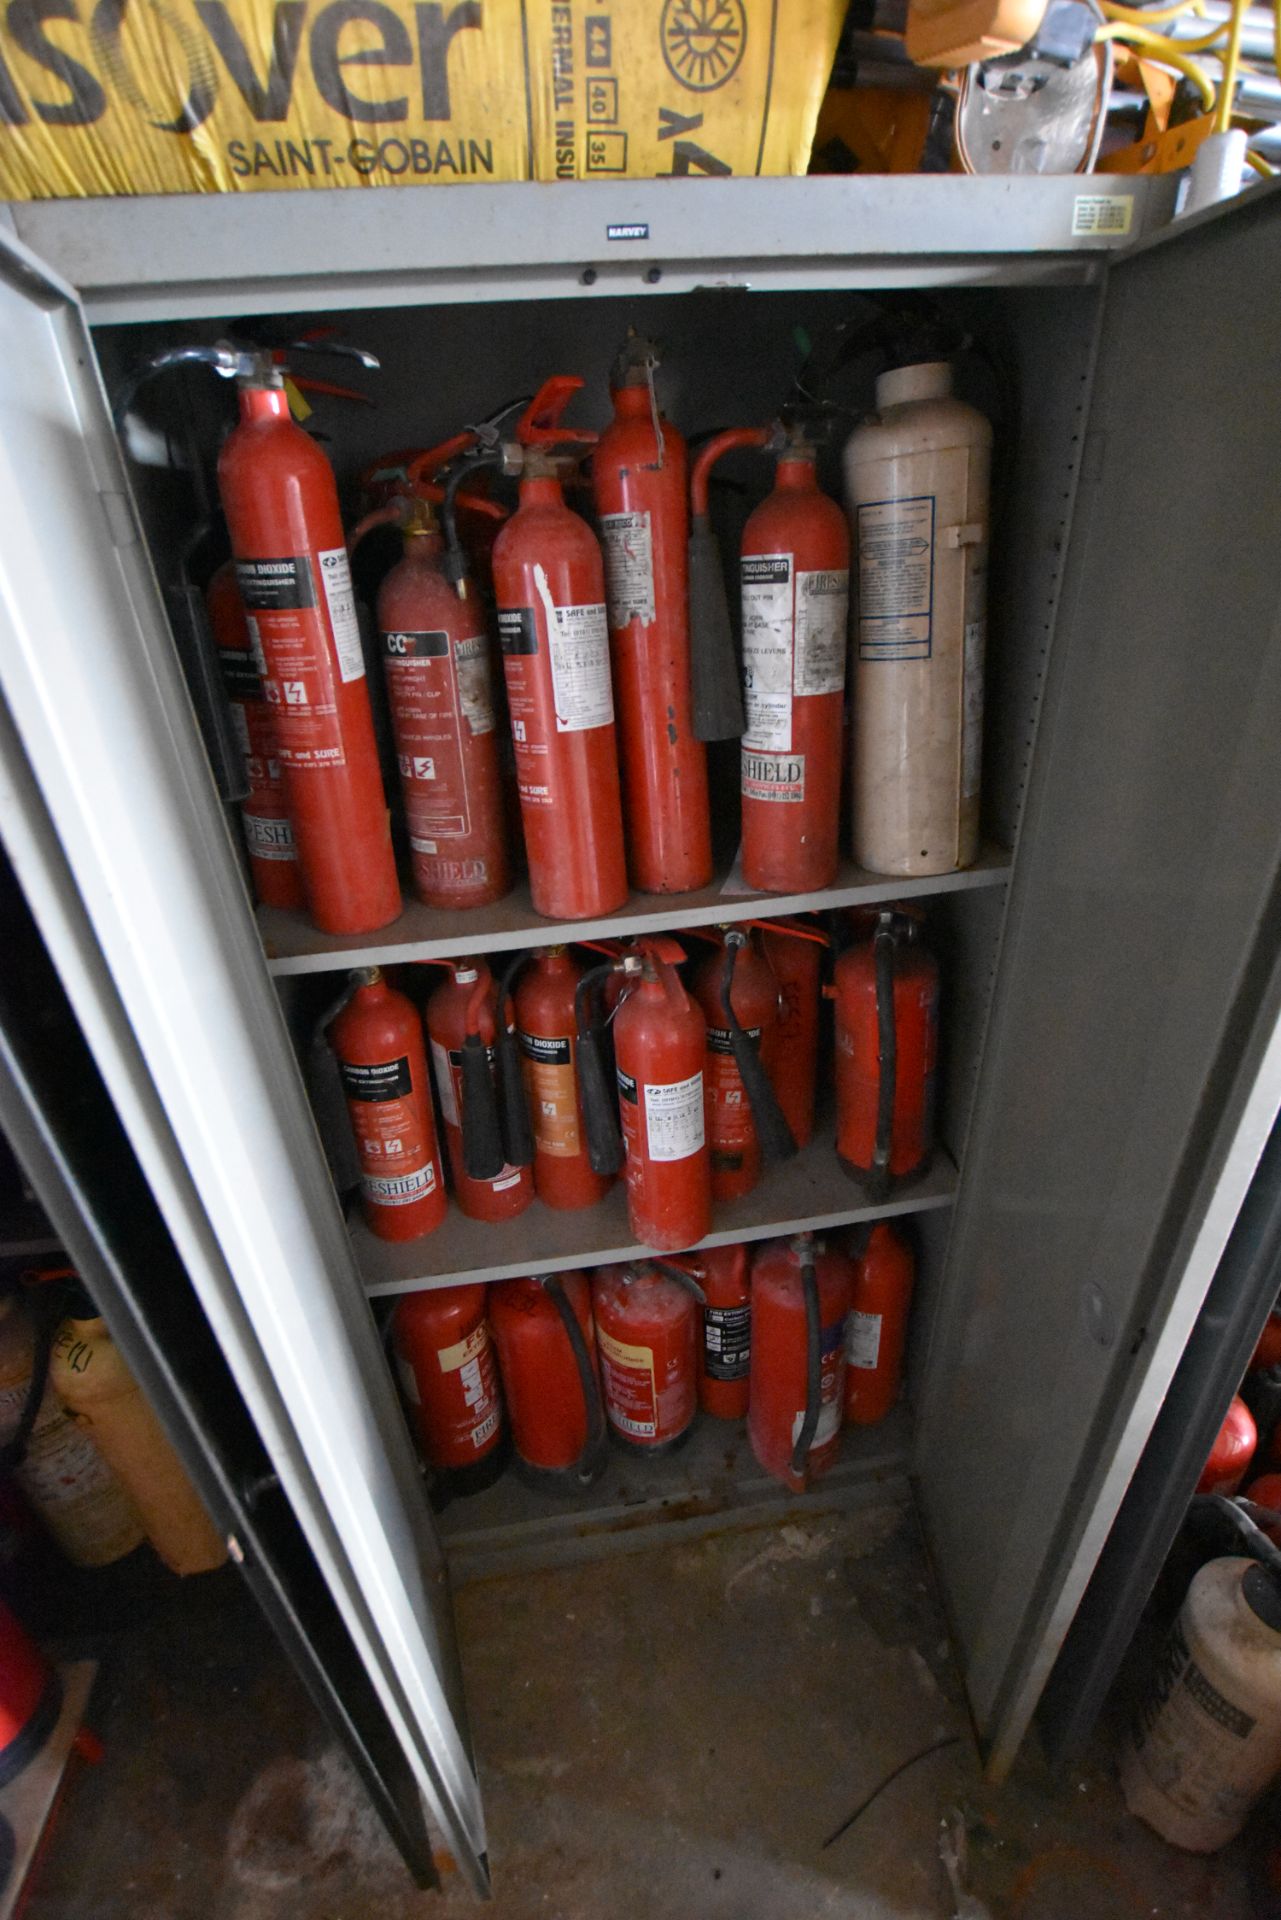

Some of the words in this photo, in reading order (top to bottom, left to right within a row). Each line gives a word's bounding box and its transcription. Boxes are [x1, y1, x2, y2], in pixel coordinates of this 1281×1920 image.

[589, 24, 607, 59] 44
[551, 0, 575, 111] ERMAL
[591, 85, 607, 114] 40
[227, 138, 495, 176] SAINT-GOBAIN
[591, 140, 606, 166] 35
[257, 563, 296, 574] DIOXIDE
[565, 608, 585, 617] SAFE
[534, 1038, 568, 1049] DIOXIDE
[370, 1063, 400, 1075] DIOXIDE
